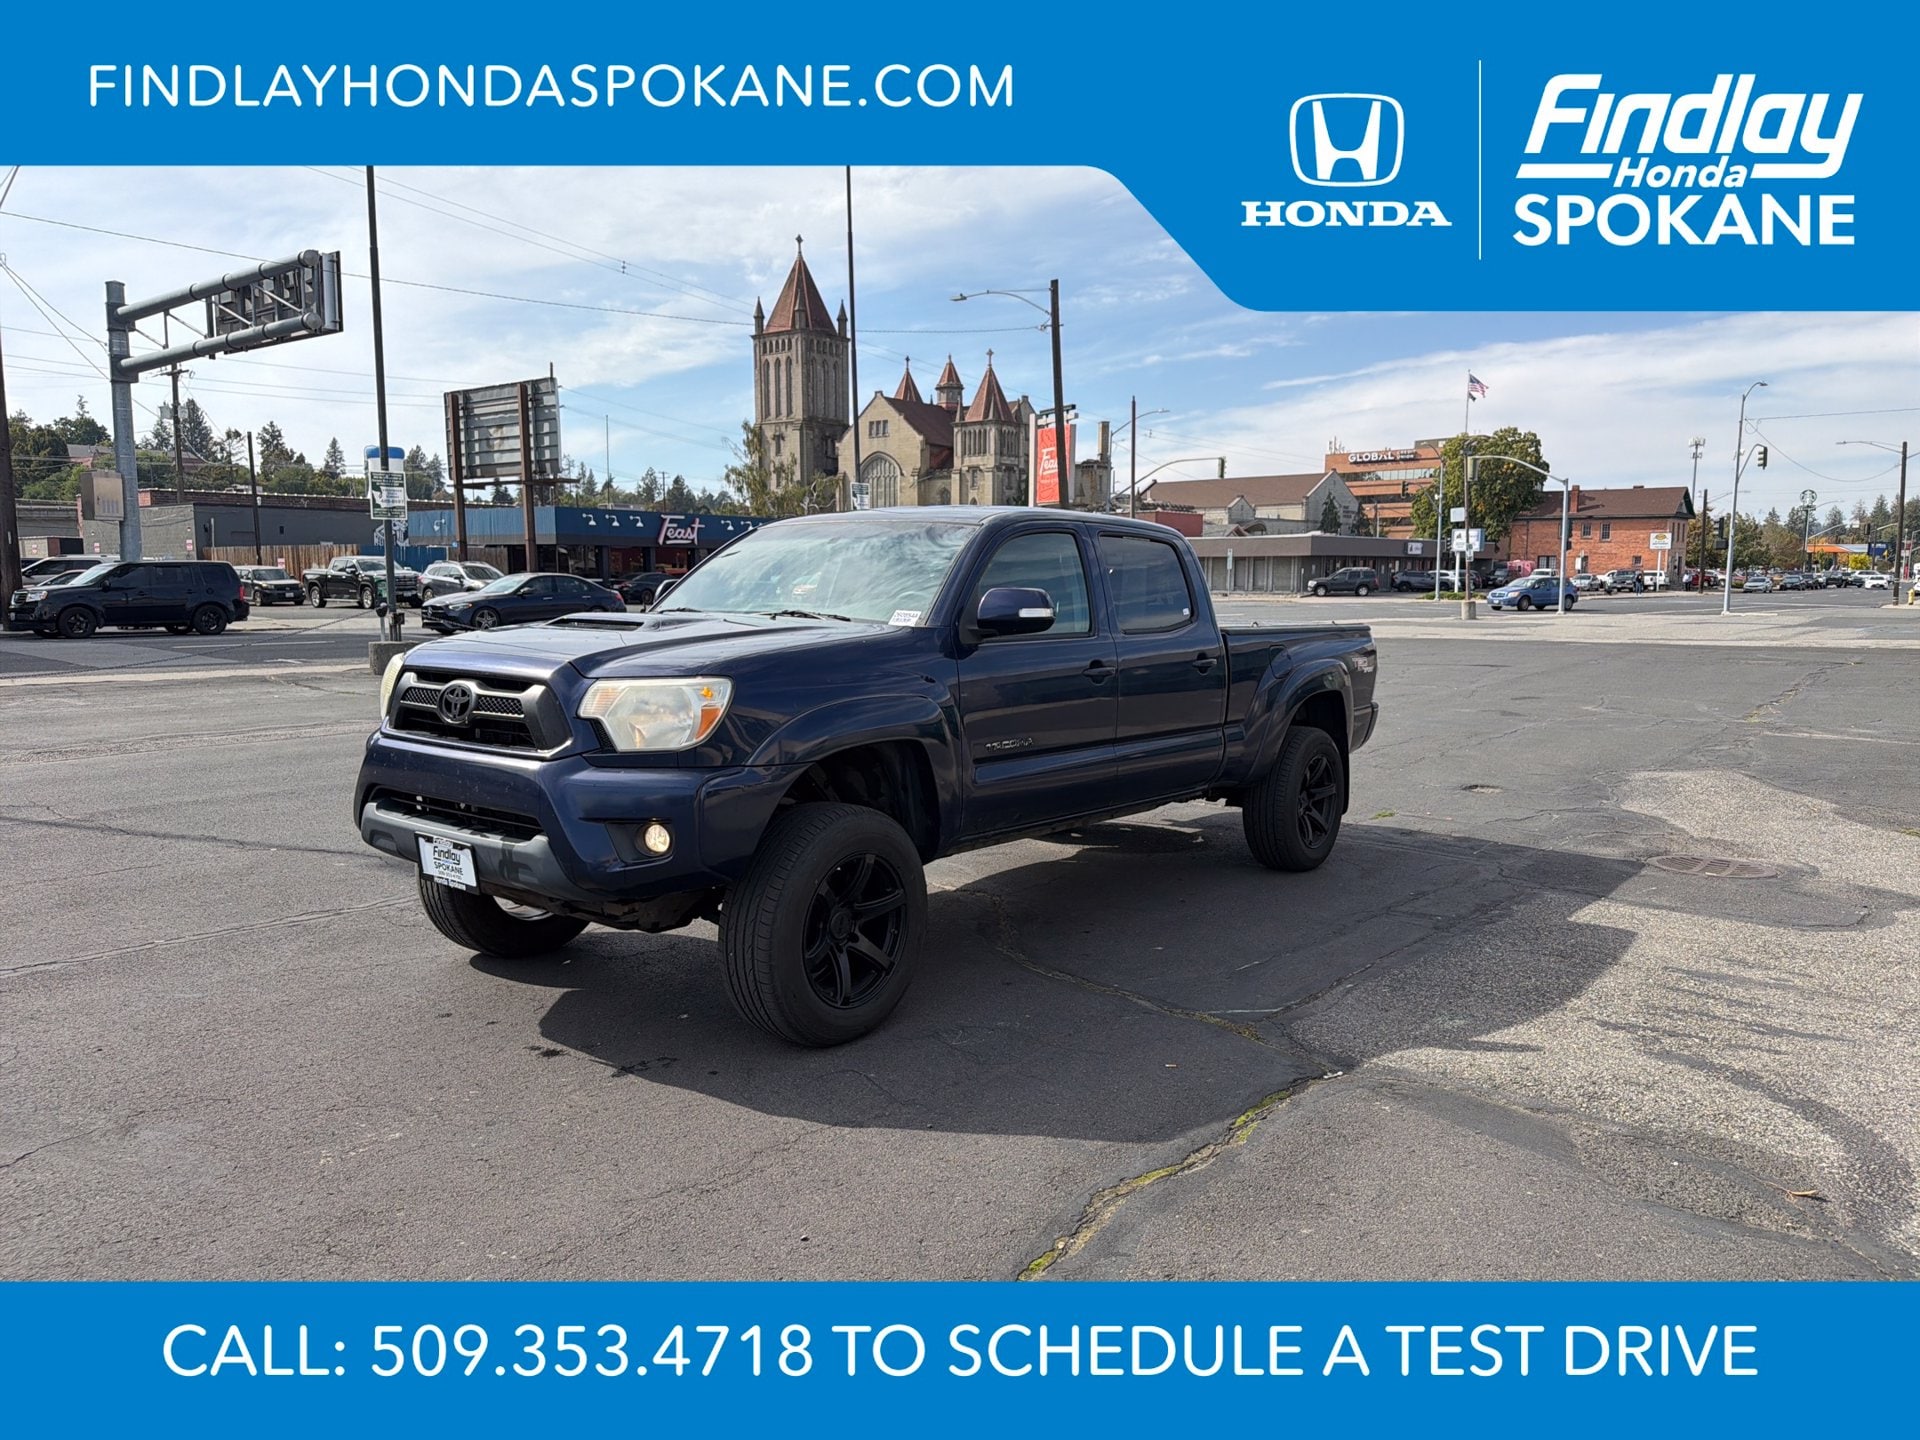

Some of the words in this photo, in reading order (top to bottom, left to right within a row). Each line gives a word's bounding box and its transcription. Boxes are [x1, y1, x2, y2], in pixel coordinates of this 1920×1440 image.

[1348, 451, 1395, 463] GLOBAL
[658, 514, 705, 546] Feast
[433, 846, 461, 865] Findlay
[433, 861, 464, 876] SPOKANE
